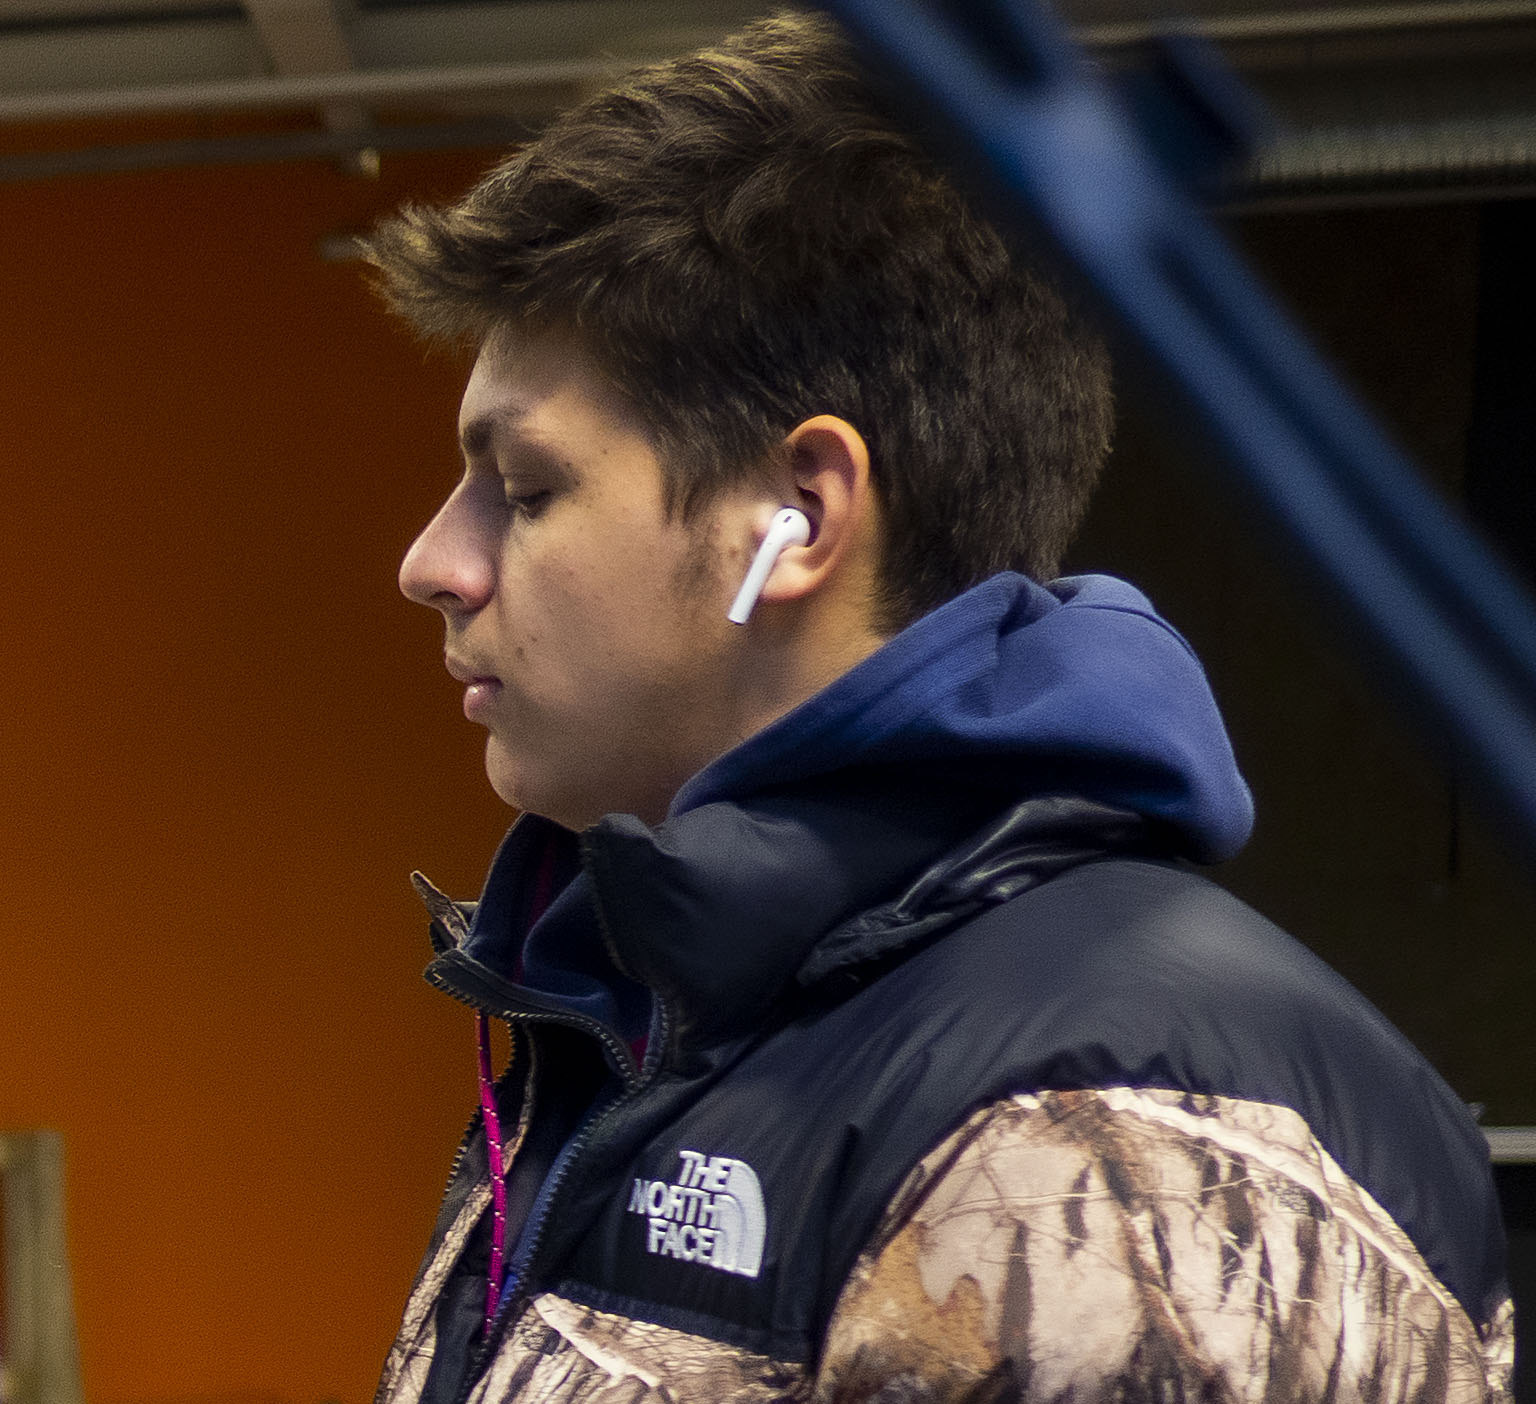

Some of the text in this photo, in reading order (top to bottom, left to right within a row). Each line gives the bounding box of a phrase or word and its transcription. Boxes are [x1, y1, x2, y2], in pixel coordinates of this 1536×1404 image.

[679, 1150, 731, 1192] THE
[627, 1178, 718, 1229] NORTH
[646, 1216, 722, 1264] FACE
